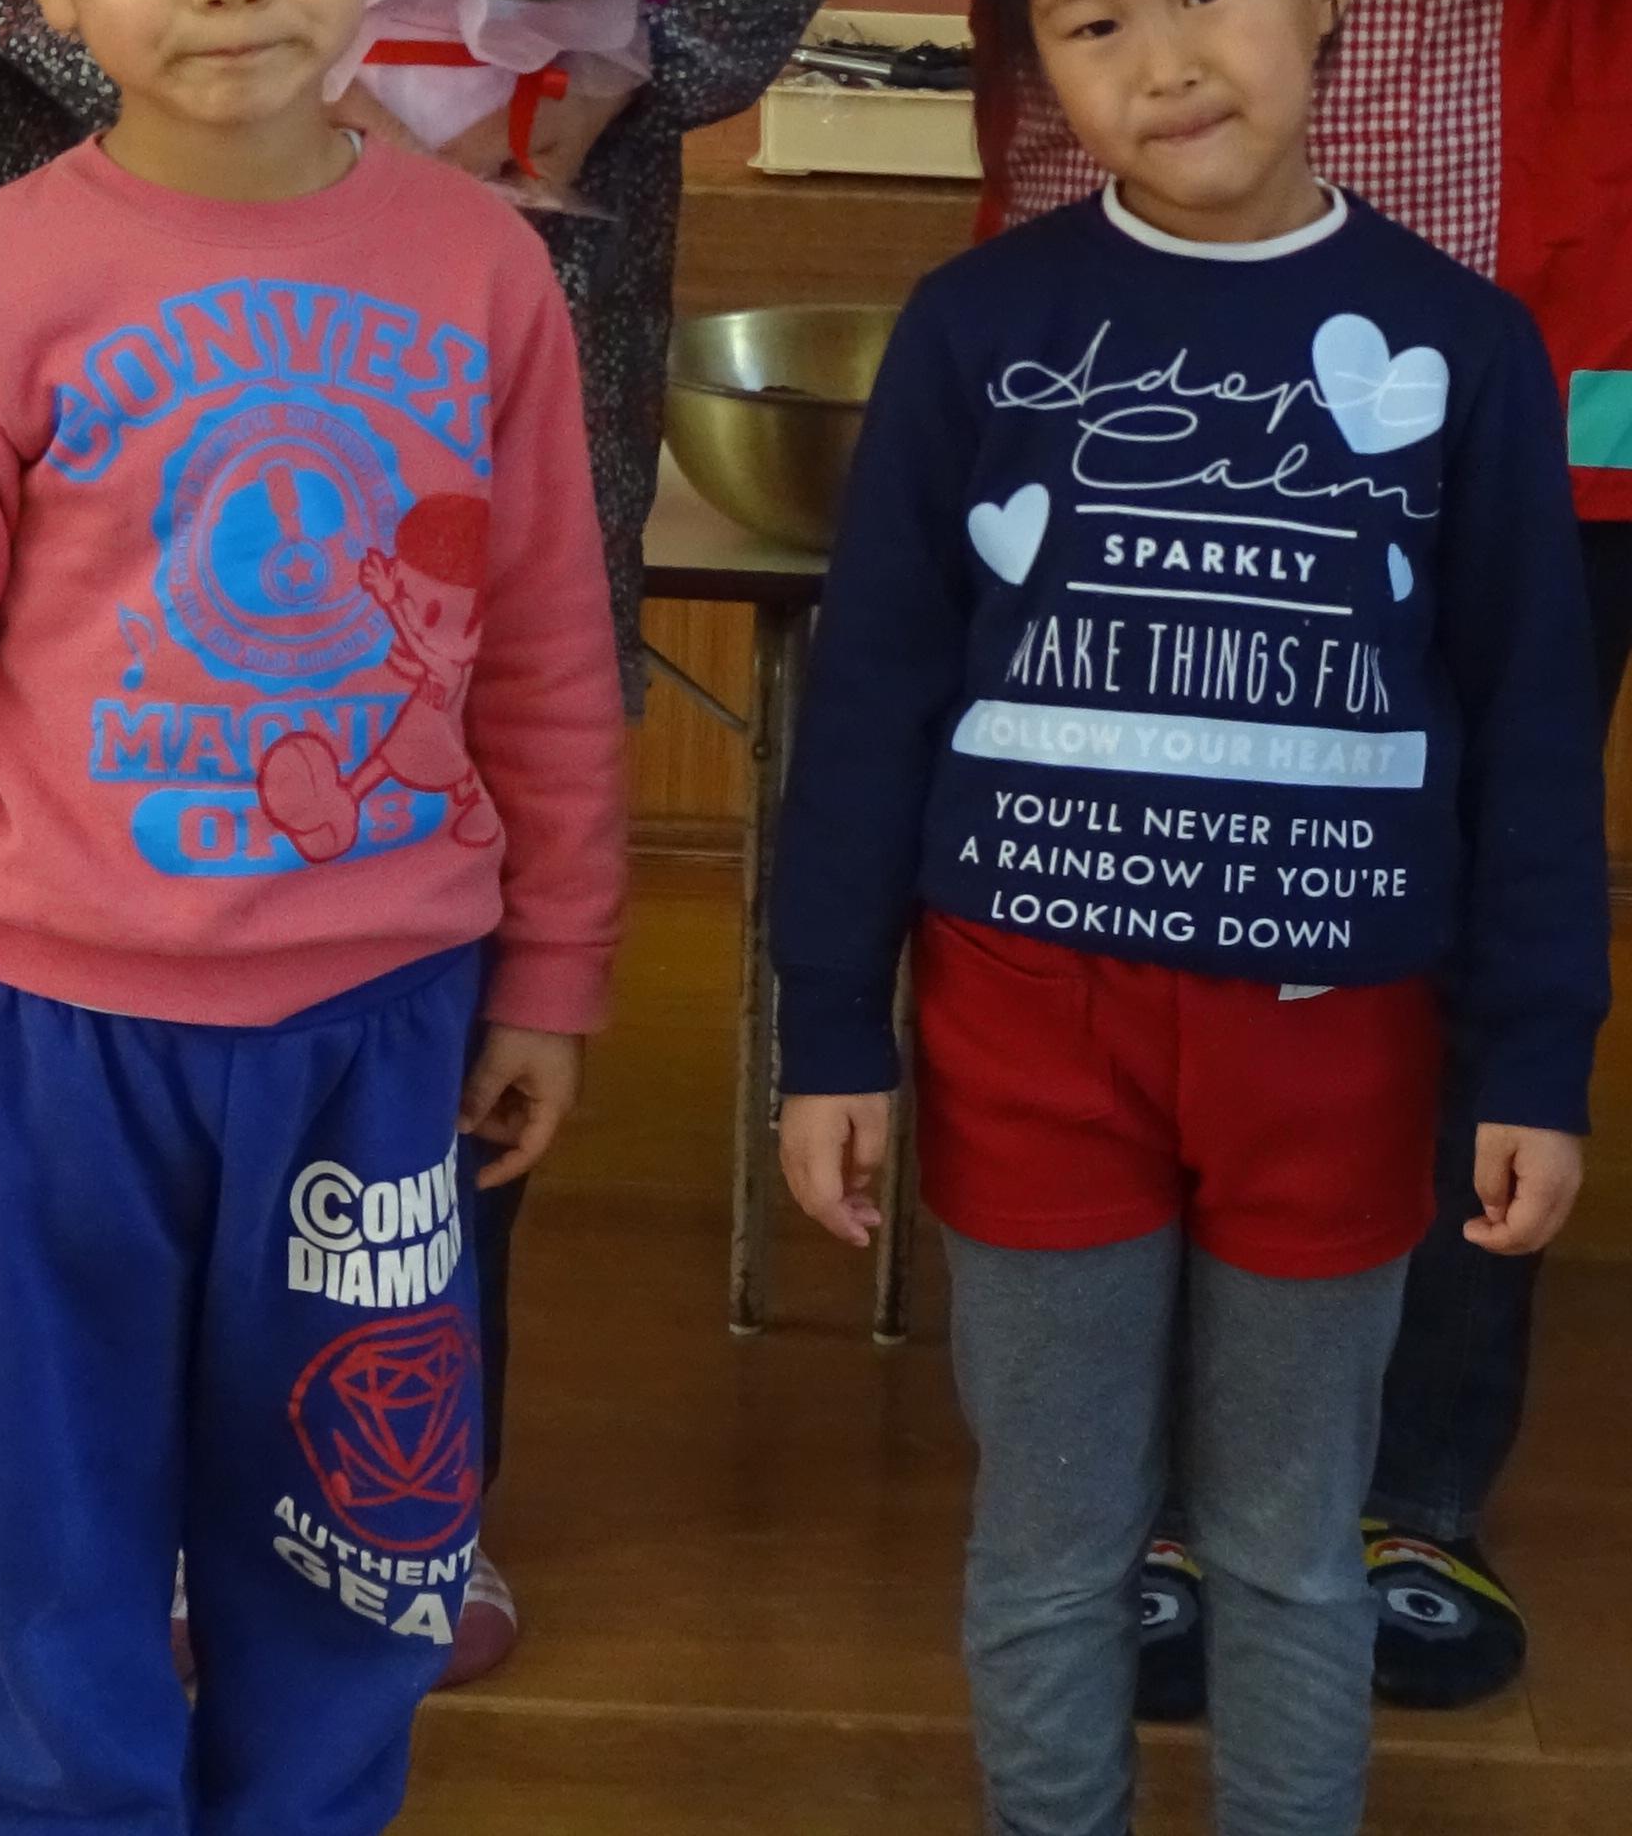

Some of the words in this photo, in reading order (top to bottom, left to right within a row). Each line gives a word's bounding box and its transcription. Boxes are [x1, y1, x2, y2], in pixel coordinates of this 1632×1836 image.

[1072, 405, 1440, 518] Calm
[1104, 534, 1317, 582] SPARKLY
[1148, 622, 1299, 707] THINGS
[974, 713, 1122, 756] FOLLOW
[1134, 726, 1252, 766] YOUR
[1269, 737, 1396, 775] HEART
[995, 790, 1123, 834] YOU'LL
[1144, 807, 1270, 846] NEVER
[1290, 817, 1374, 849] FIND
[959, 835, 980, 864] A
[998, 839, 1203, 889] RAINBOW
[1223, 863, 1257, 894] IF
[1277, 866, 1407, 898] YOU'RE
[990, 890, 1196, 943] LOOKING
[1218, 916, 1351, 949] DOWN
[288, 1212, 462, 1308] DIAMO
[273, 1536, 468, 1645] GEA
